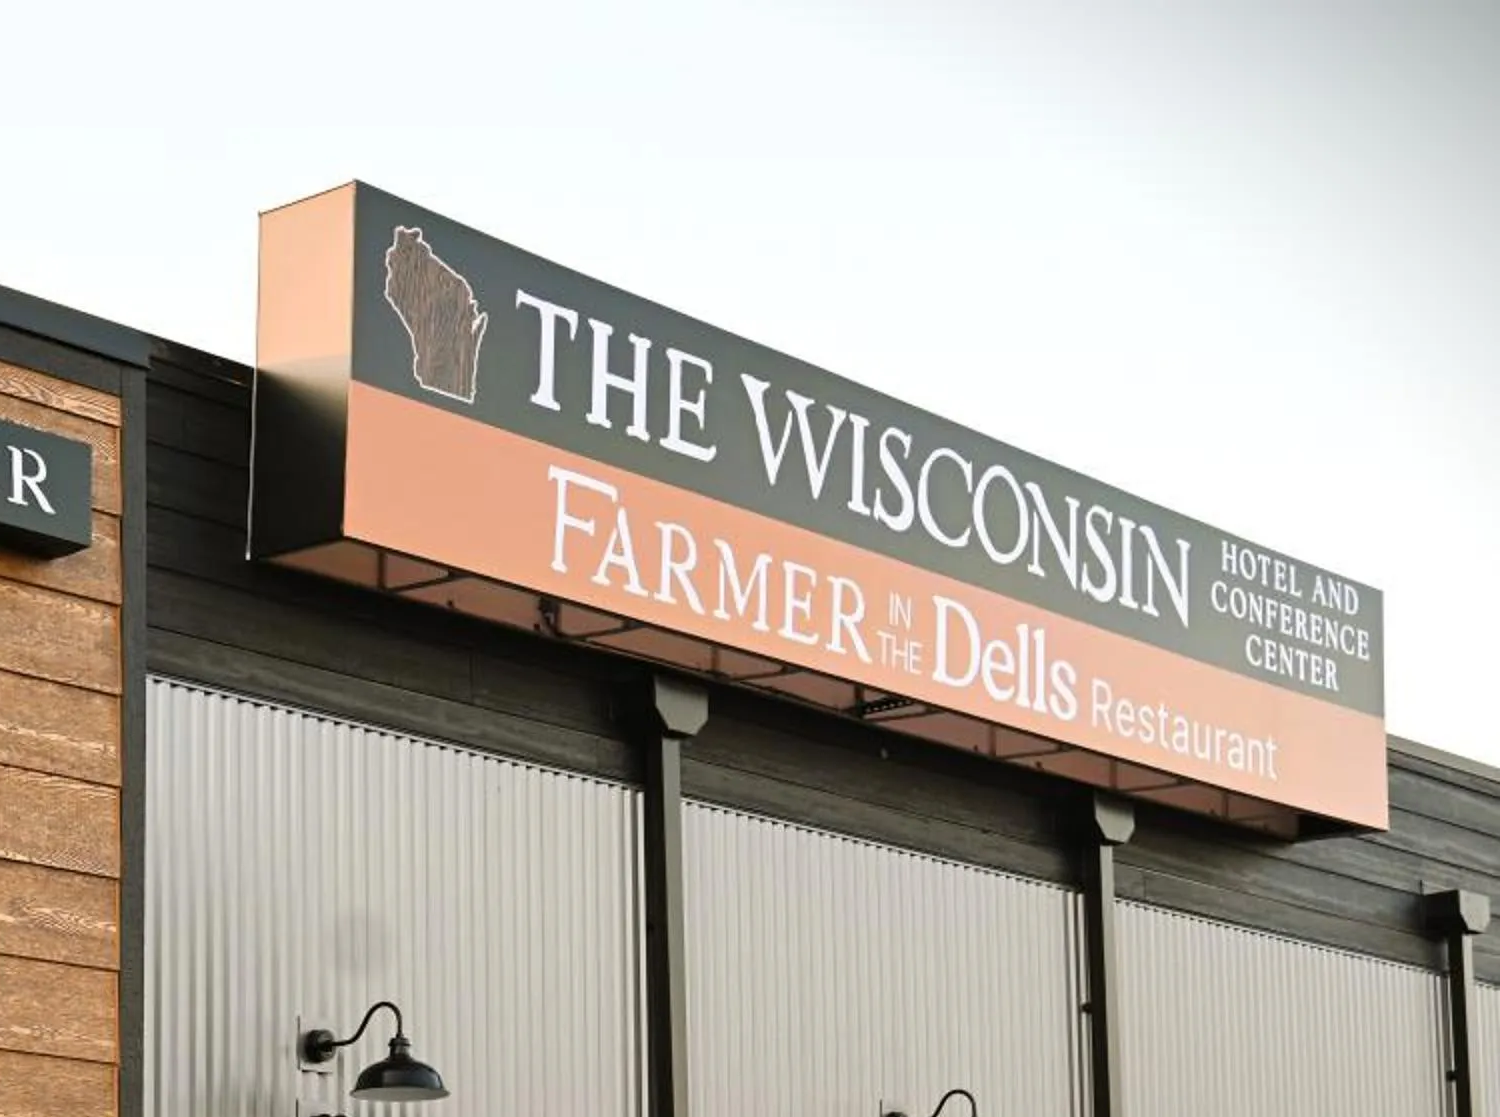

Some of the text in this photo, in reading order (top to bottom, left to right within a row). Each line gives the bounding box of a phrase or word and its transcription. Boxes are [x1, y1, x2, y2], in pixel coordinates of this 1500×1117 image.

[516, 289, 1191, 629] THE WISCONSIN
[1221, 540, 1359, 615] HOTEL AND
[547, 464, 1278, 781] FARMER IN THE Dells Restaurant
[1211, 580, 1370, 661] CONFERENCE
[1245, 634, 1339, 691] CENTER
